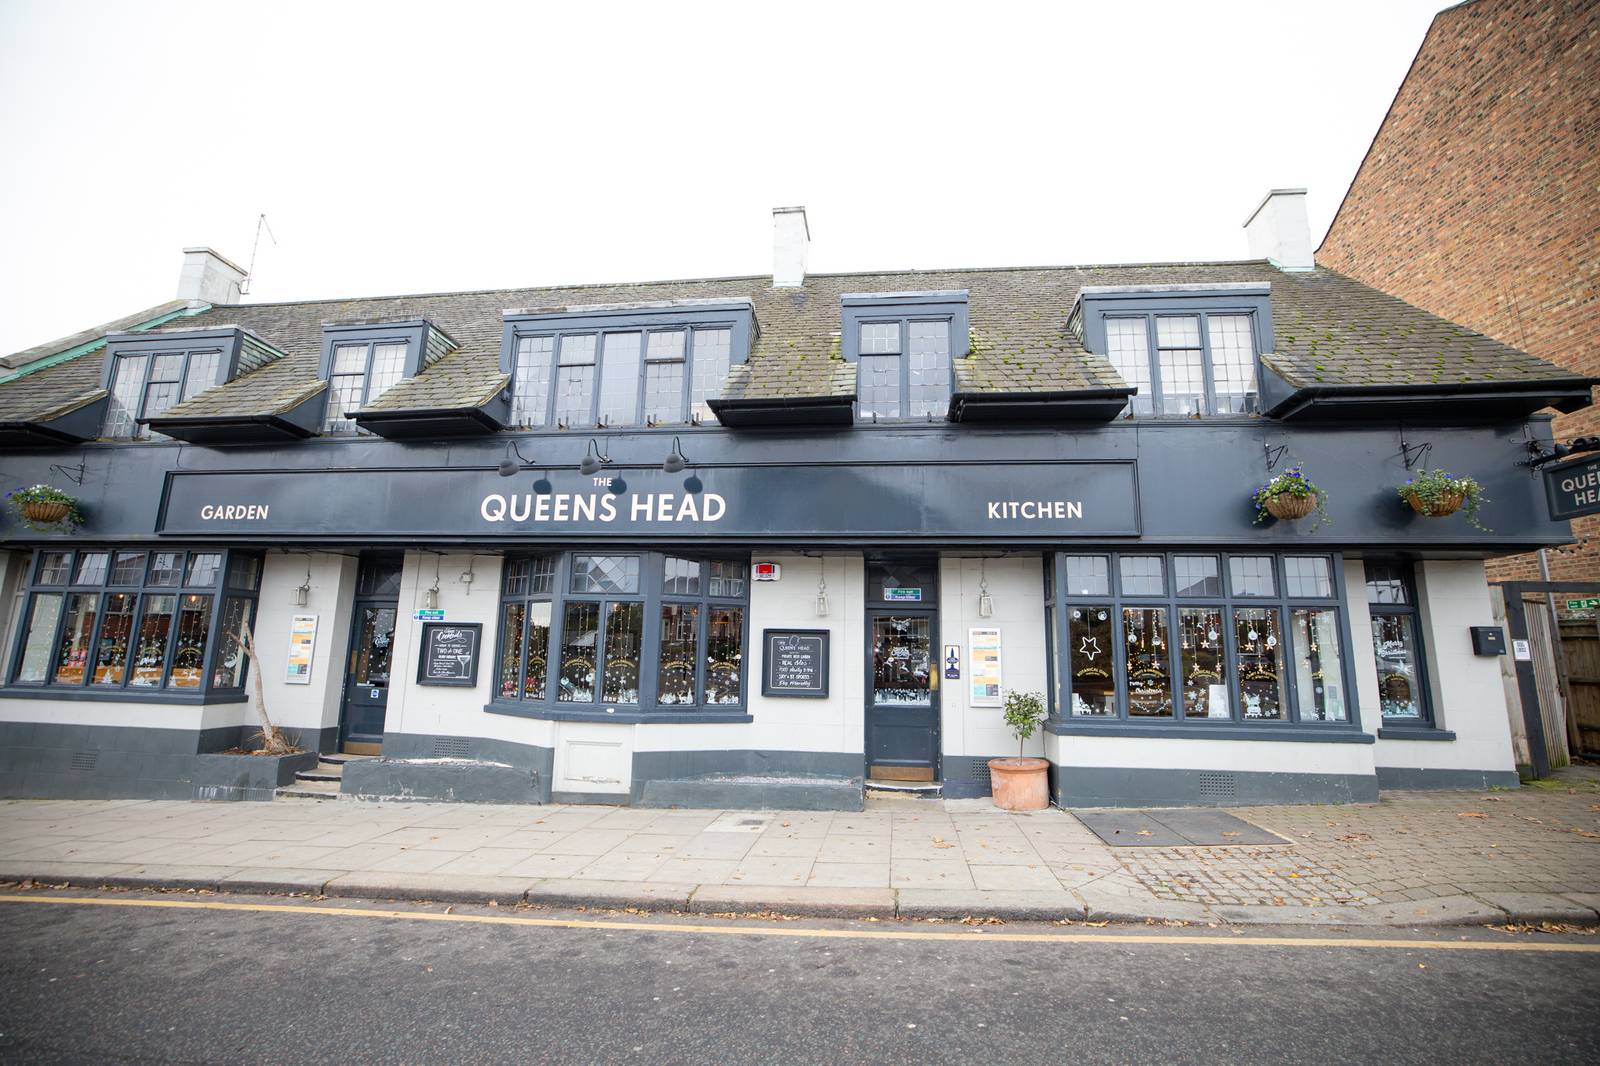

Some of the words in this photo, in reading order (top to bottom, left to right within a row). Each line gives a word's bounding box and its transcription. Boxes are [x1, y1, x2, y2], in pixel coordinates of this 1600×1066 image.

[593, 478, 613, 487] THE
[201, 505, 269, 520] GARDEN
[480, 494, 617, 522] QUEENS
[630, 493, 727, 522] HEAD
[988, 501, 1082, 519] KITCHEN
